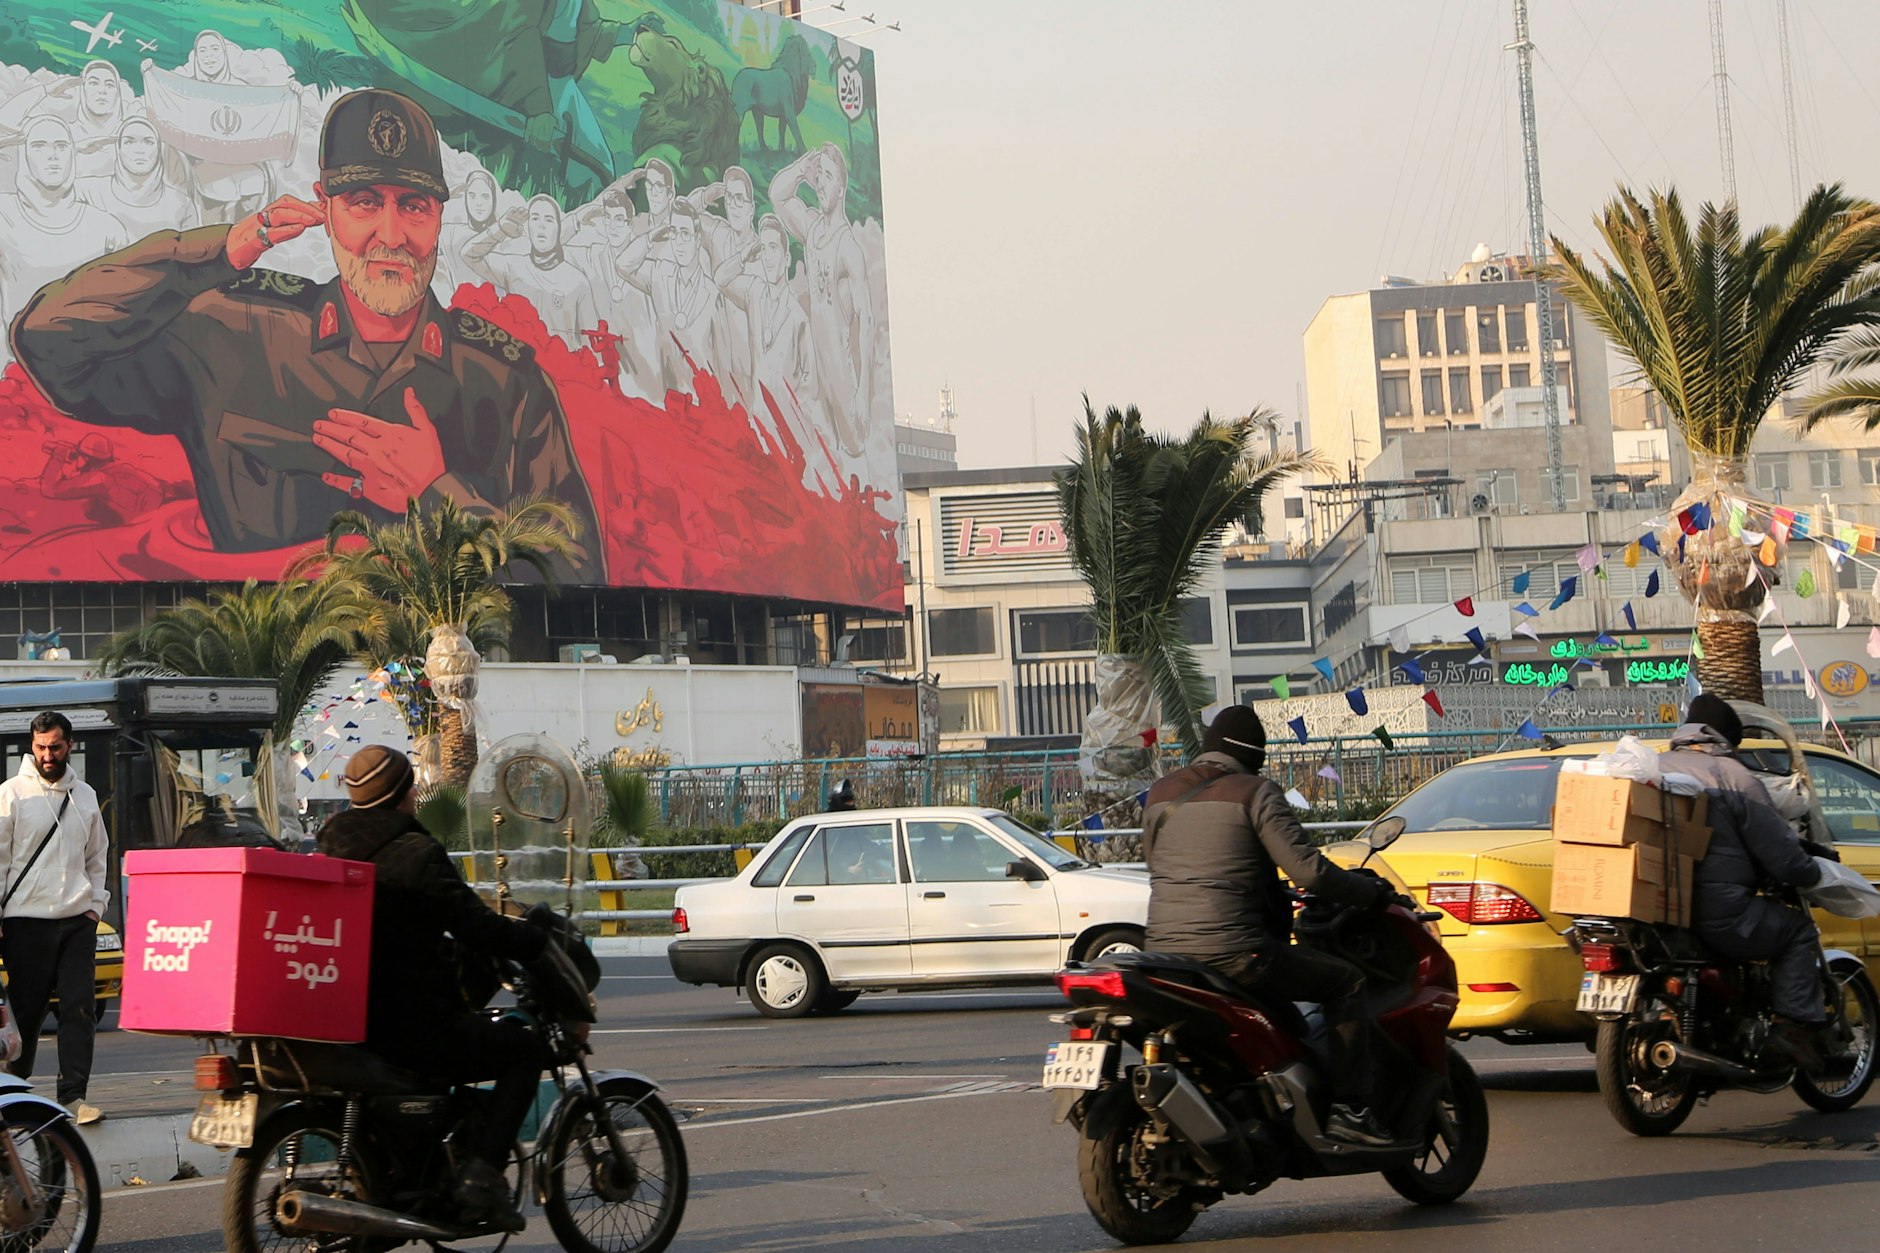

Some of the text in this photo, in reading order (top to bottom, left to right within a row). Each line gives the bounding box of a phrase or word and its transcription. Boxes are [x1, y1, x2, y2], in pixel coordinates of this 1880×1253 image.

[1444, 661, 1492, 686] مرکز
[1504, 663, 1569, 688] داروخانه
[1627, 659, 1690, 683] داروخانه
[1571, 705, 1586, 719] ولی
[1588, 705, 1618, 718] حضرت
[145, 919, 213, 949] Snapp!
[143, 946, 190, 972] Food
[286, 958, 339, 989] فود
